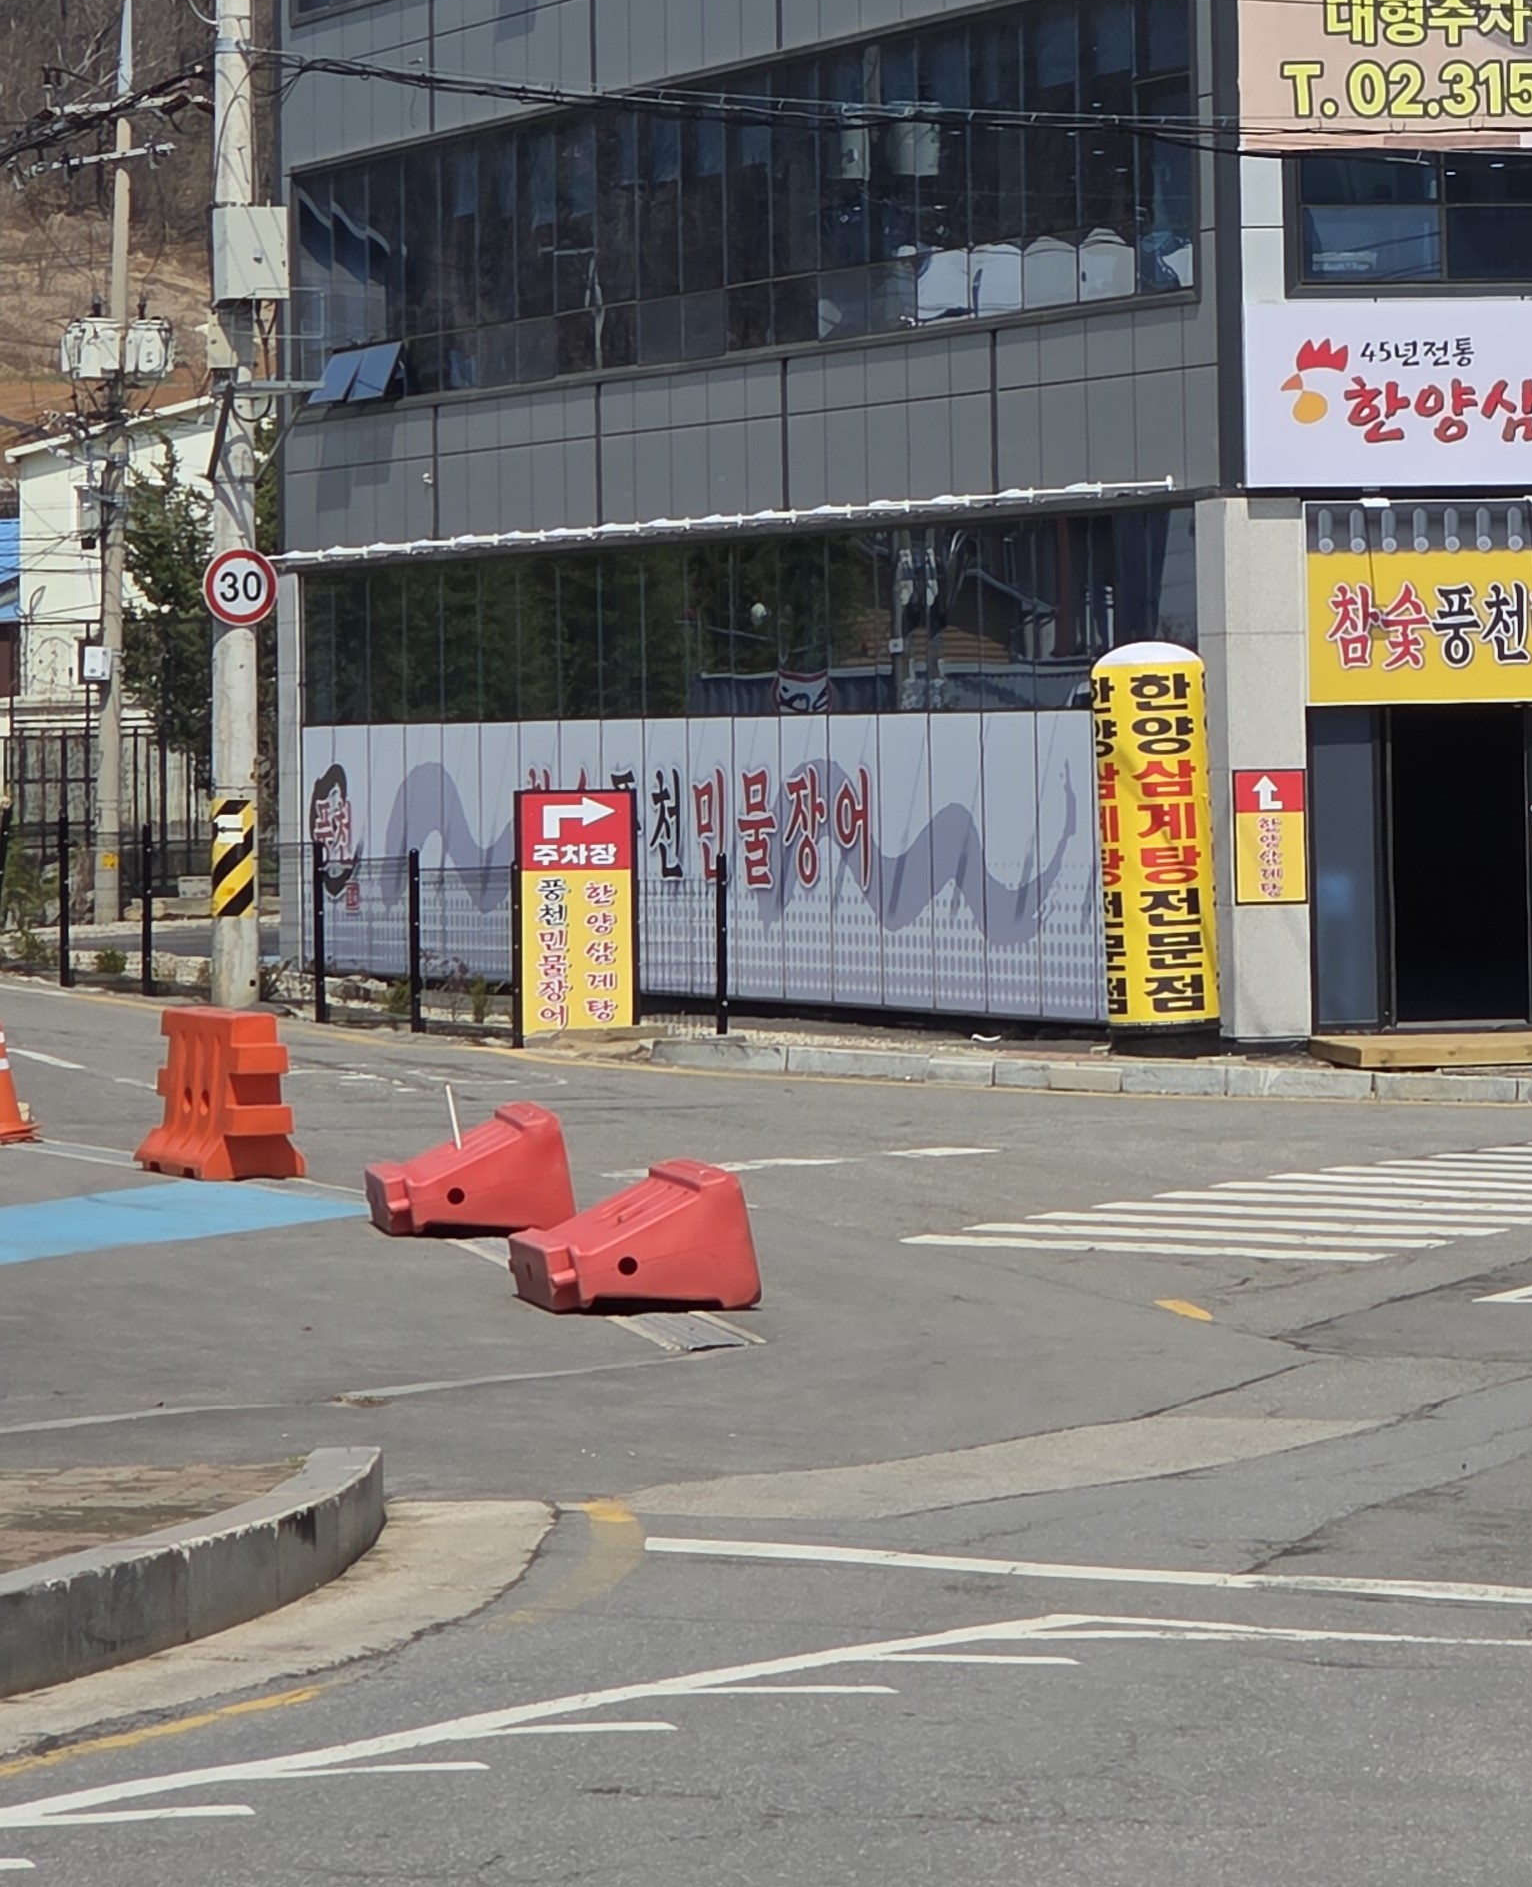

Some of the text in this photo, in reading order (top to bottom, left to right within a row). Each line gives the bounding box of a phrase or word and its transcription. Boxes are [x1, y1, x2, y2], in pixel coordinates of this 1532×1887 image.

[1359, 338, 1475, 367] 45년전통
[219, 570, 263, 604] 30
[533, 844, 617, 865] 주차장
[538, 879, 571, 1027] 풍천민물장어
[586, 883, 617, 1020] 한양삼계탕
